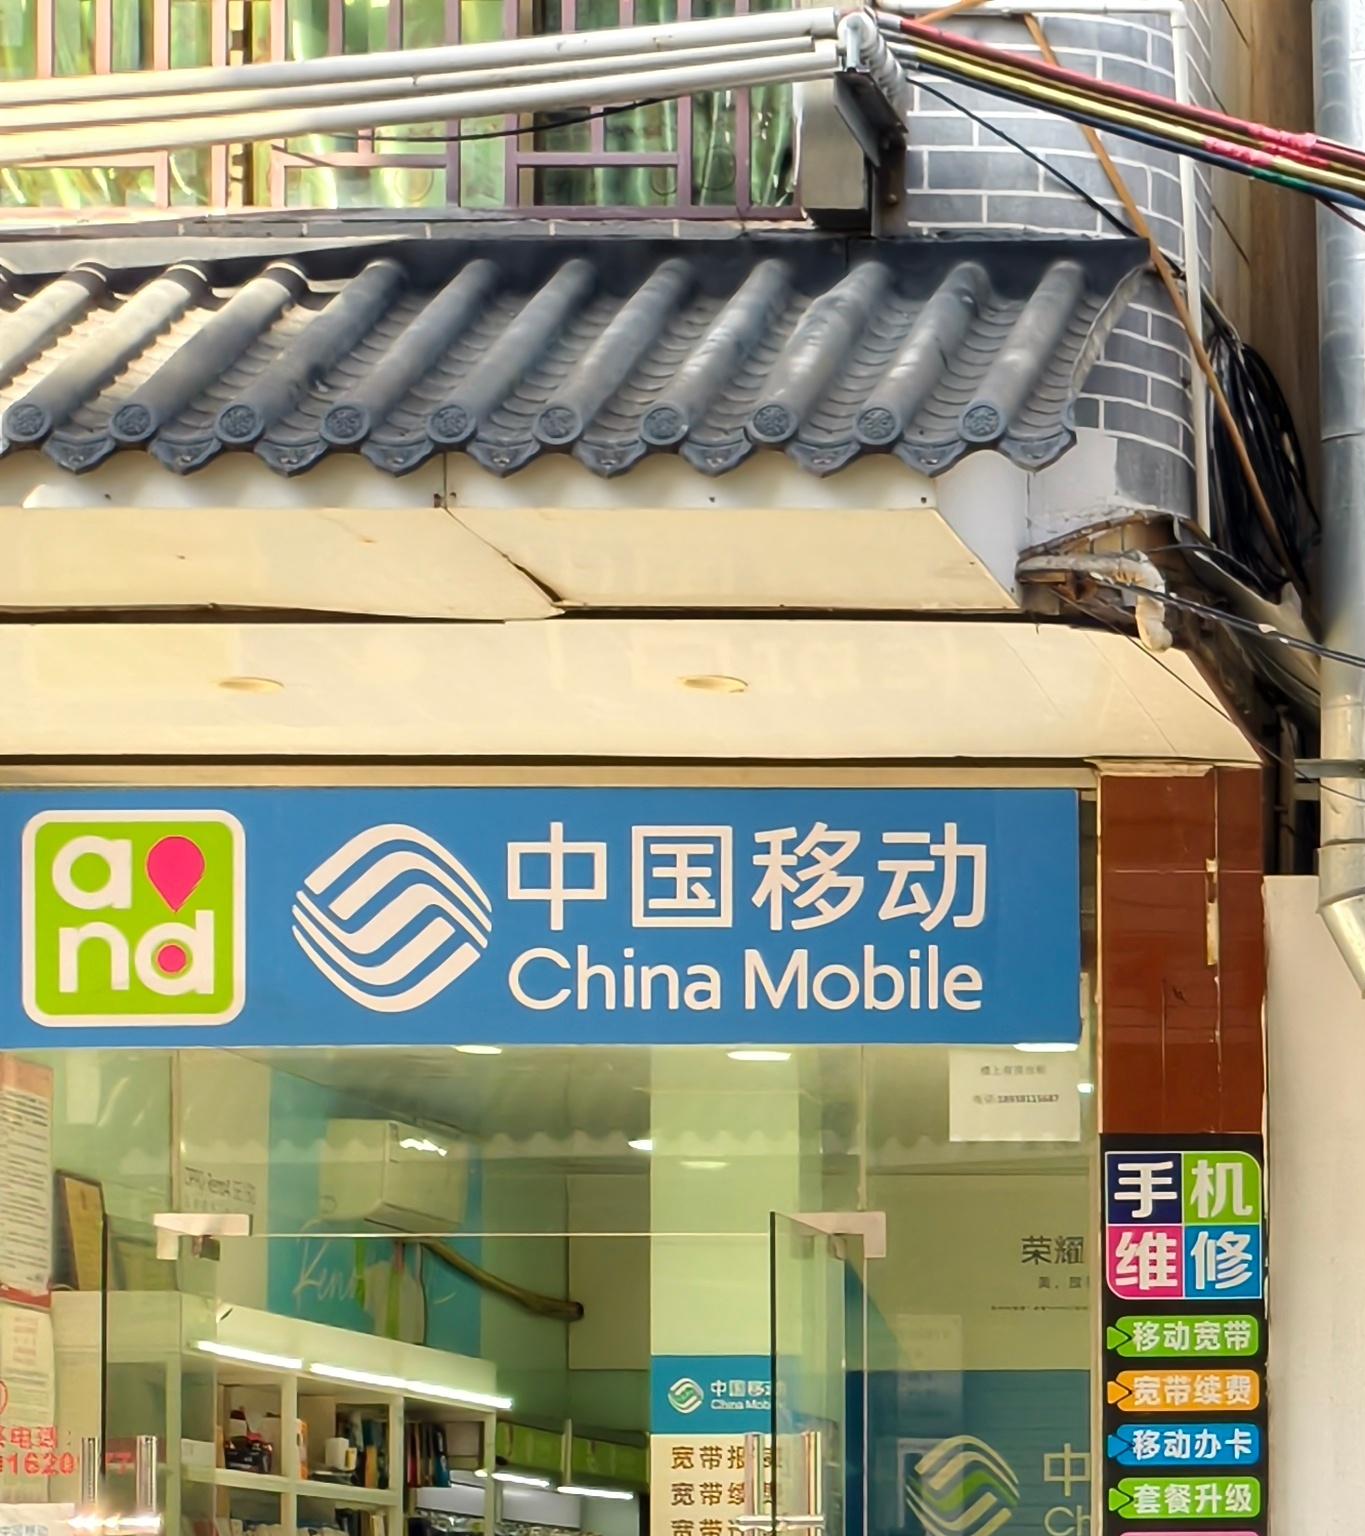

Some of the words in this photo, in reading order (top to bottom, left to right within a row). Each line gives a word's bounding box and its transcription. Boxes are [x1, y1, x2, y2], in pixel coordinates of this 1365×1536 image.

[507, 821, 988, 931] 中国移动
[508, 945, 721, 1011] China
[744, 944, 983, 1011] Mobile
[1114, 1160, 1253, 1219] 手机
[1114, 1230, 1253, 1291] 维修
[1132, 1321, 1252, 1352] 移动宽带
[1132, 1375, 1252, 1407] 宽带续费
[1132, 1429, 1253, 1460] 移动办卡
[1133, 1483, 1253, 1514] 套餐升级
